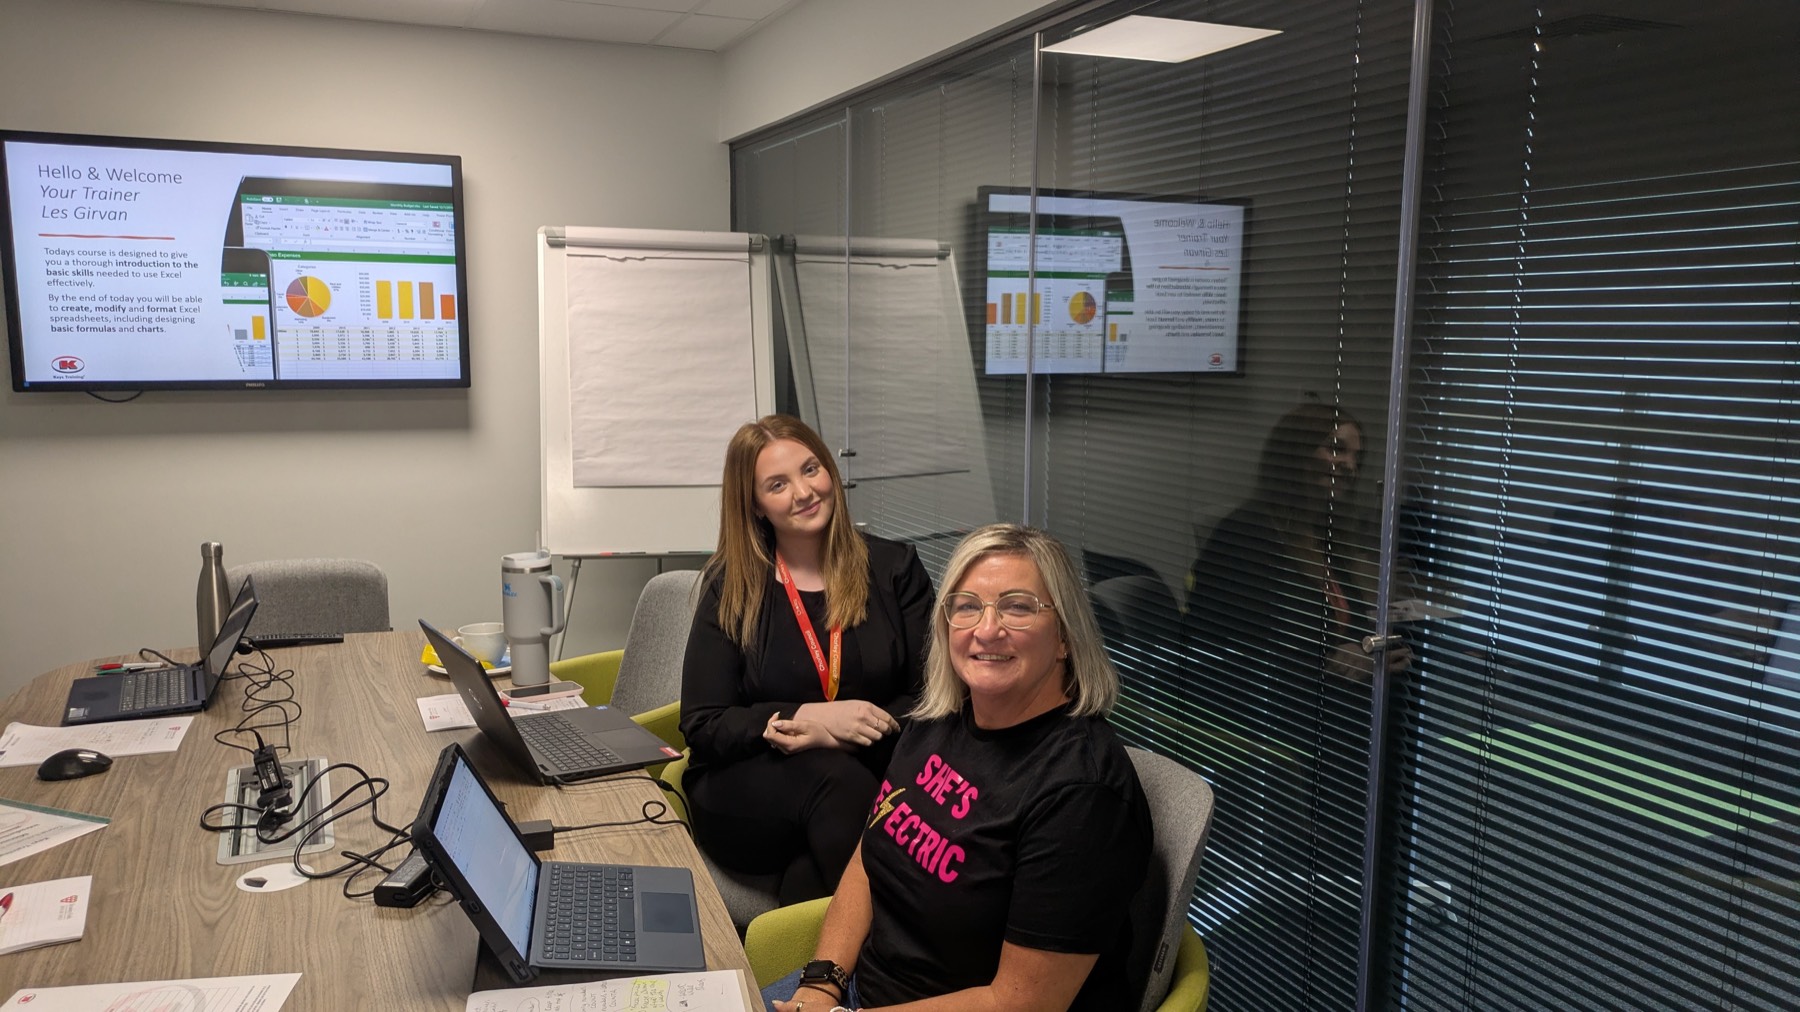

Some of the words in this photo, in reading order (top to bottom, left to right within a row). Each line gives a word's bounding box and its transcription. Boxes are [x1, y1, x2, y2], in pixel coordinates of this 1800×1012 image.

[38, 164, 82, 180] Hello
[87, 166, 100, 181] &
[105, 168, 183, 185] Welcome
[40, 185, 77, 199] Your
[82, 186, 140, 202] Trainer
[41, 205, 68, 219] Les
[74, 206, 128, 221] Girvan
[44, 248, 75, 259] Todays
[109, 249, 116, 257] is
[118, 249, 157, 260] designed
[159, 251, 169, 259] to
[170, 251, 188, 260] give
[45, 259, 62, 267] you
[72, 259, 113, 269] thorough
[115, 260, 171, 269] introduction
[172, 261, 182, 269] to
[183, 261, 199, 269] the
[46, 268, 70, 277] basic
[71, 269, 94, 278] skills
[96, 270, 130, 278] needed
[131, 270, 141, 279] to
[160, 270, 182, 279] Excel
[46, 278, 95, 288] effectively.
[48, 293, 60, 303] By
[61, 294, 77, 302] the
[79, 294, 96, 302] end
[98, 294, 108, 302] of
[109, 294, 135, 305] today
[136, 296, 153, 305] you
[155, 295, 170, 303] will
[171, 296, 183, 304] be
[185, 295, 203, 304] able
[49, 304, 59, 312] to
[61, 305, 93, 313] create,
[95, 304, 126, 315] modify
[128, 305, 145, 313] and
[147, 305, 177, 313] format
[179, 305, 201, 313] Excel
[50, 314, 112, 324] spreadsheets,
[113, 315, 153, 325] including
[154, 315, 196, 325] designing
[51, 324, 74, 333] basic
[76, 324, 117, 334] formulas
[118, 325, 135, 333] and
[137, 325, 167, 333] charts.
[805, 630, 817, 650] Council
[814, 650, 825, 672] Chorley
[916, 754, 979, 819] SHE'S
[869, 779, 966, 883] EECTRIC
